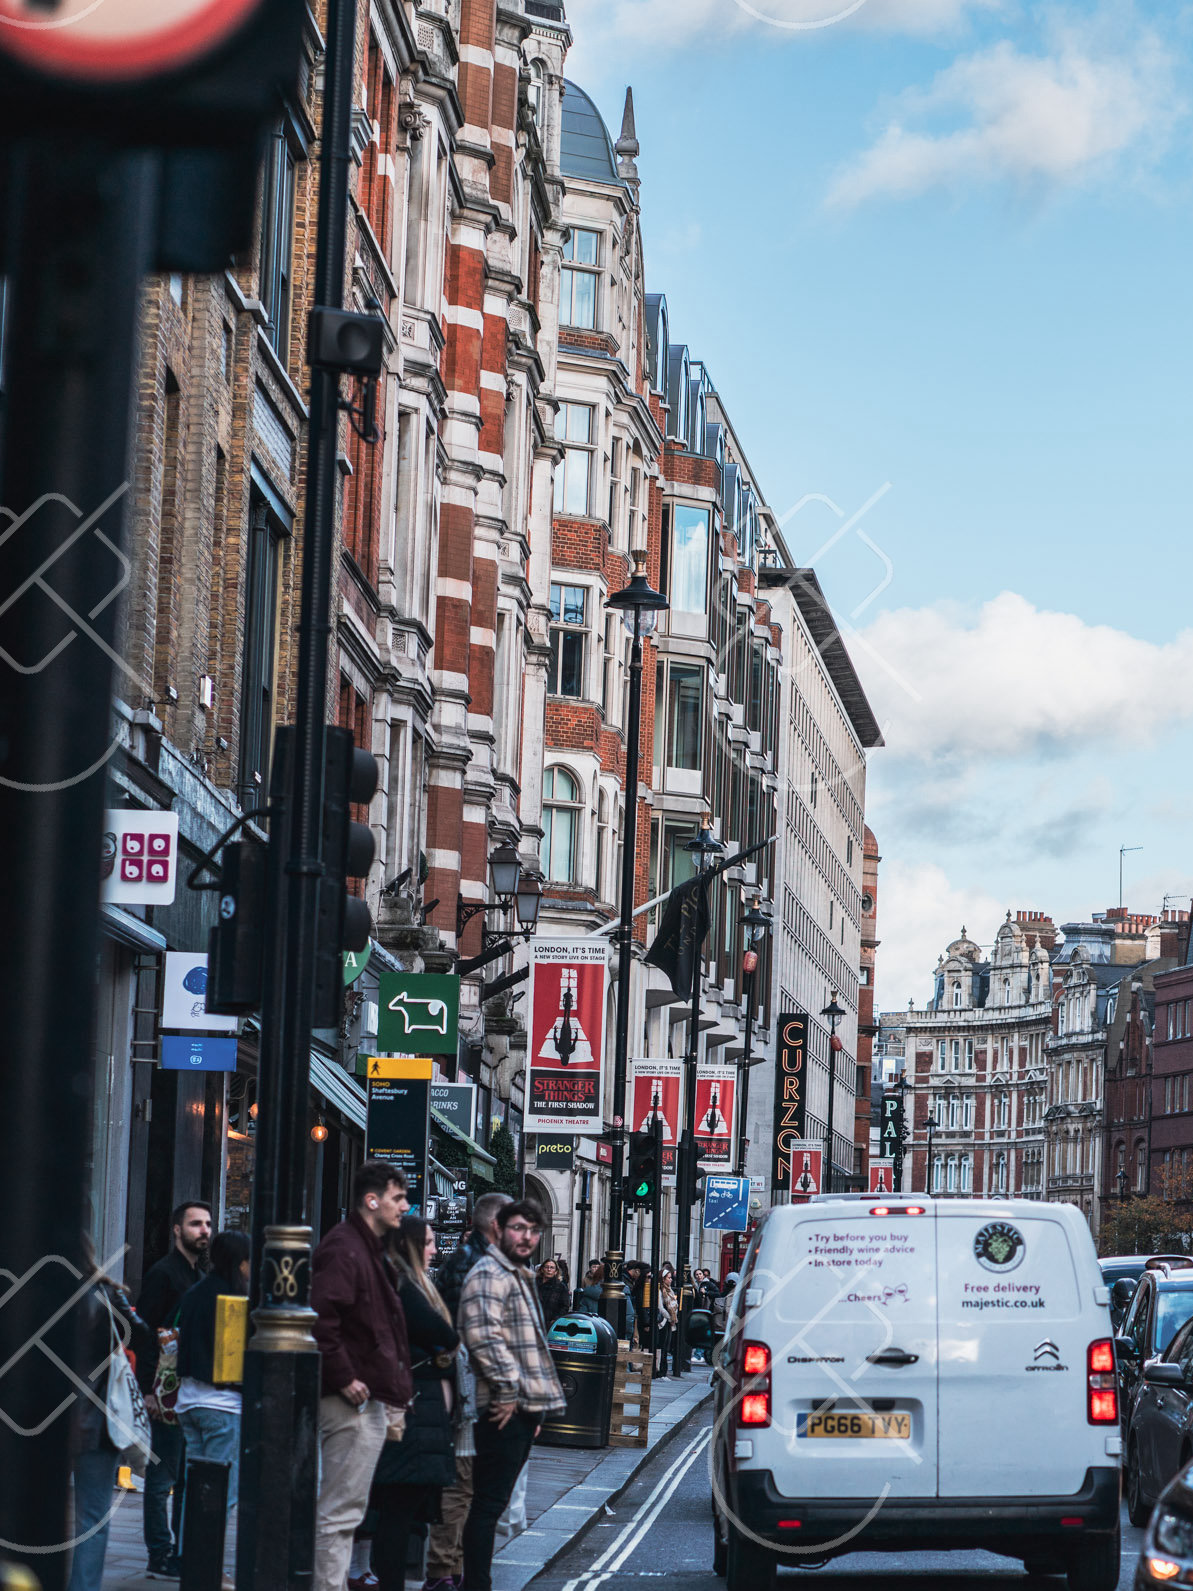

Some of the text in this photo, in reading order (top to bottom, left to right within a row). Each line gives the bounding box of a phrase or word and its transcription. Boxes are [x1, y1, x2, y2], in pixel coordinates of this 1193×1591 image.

[534, 946, 570, 954] LONDON,
[371, 1087, 408, 1095] Shaftesbury
[534, 1079, 595, 1093] STRANGER
[431, 1088, 449, 1097] ACCO
[544, 1091, 585, 1101] THINGS
[431, 1101, 458, 1110] RINKS
[538, 1144, 572, 1154] preto
[814, 1232, 909, 1244] Try before you buy
[975, 1223, 1021, 1254] MAJESTIC
[814, 1245, 915, 1256] Friendly wine advice
[814, 1259, 824, 1267] In
[855, 1257, 883, 1267] today
[964, 1282, 1041, 1295] Free delivery
[962, 1298, 1045, 1310] majestic.co.uk
[810, 1416, 906, 1434] PG66 TVY
